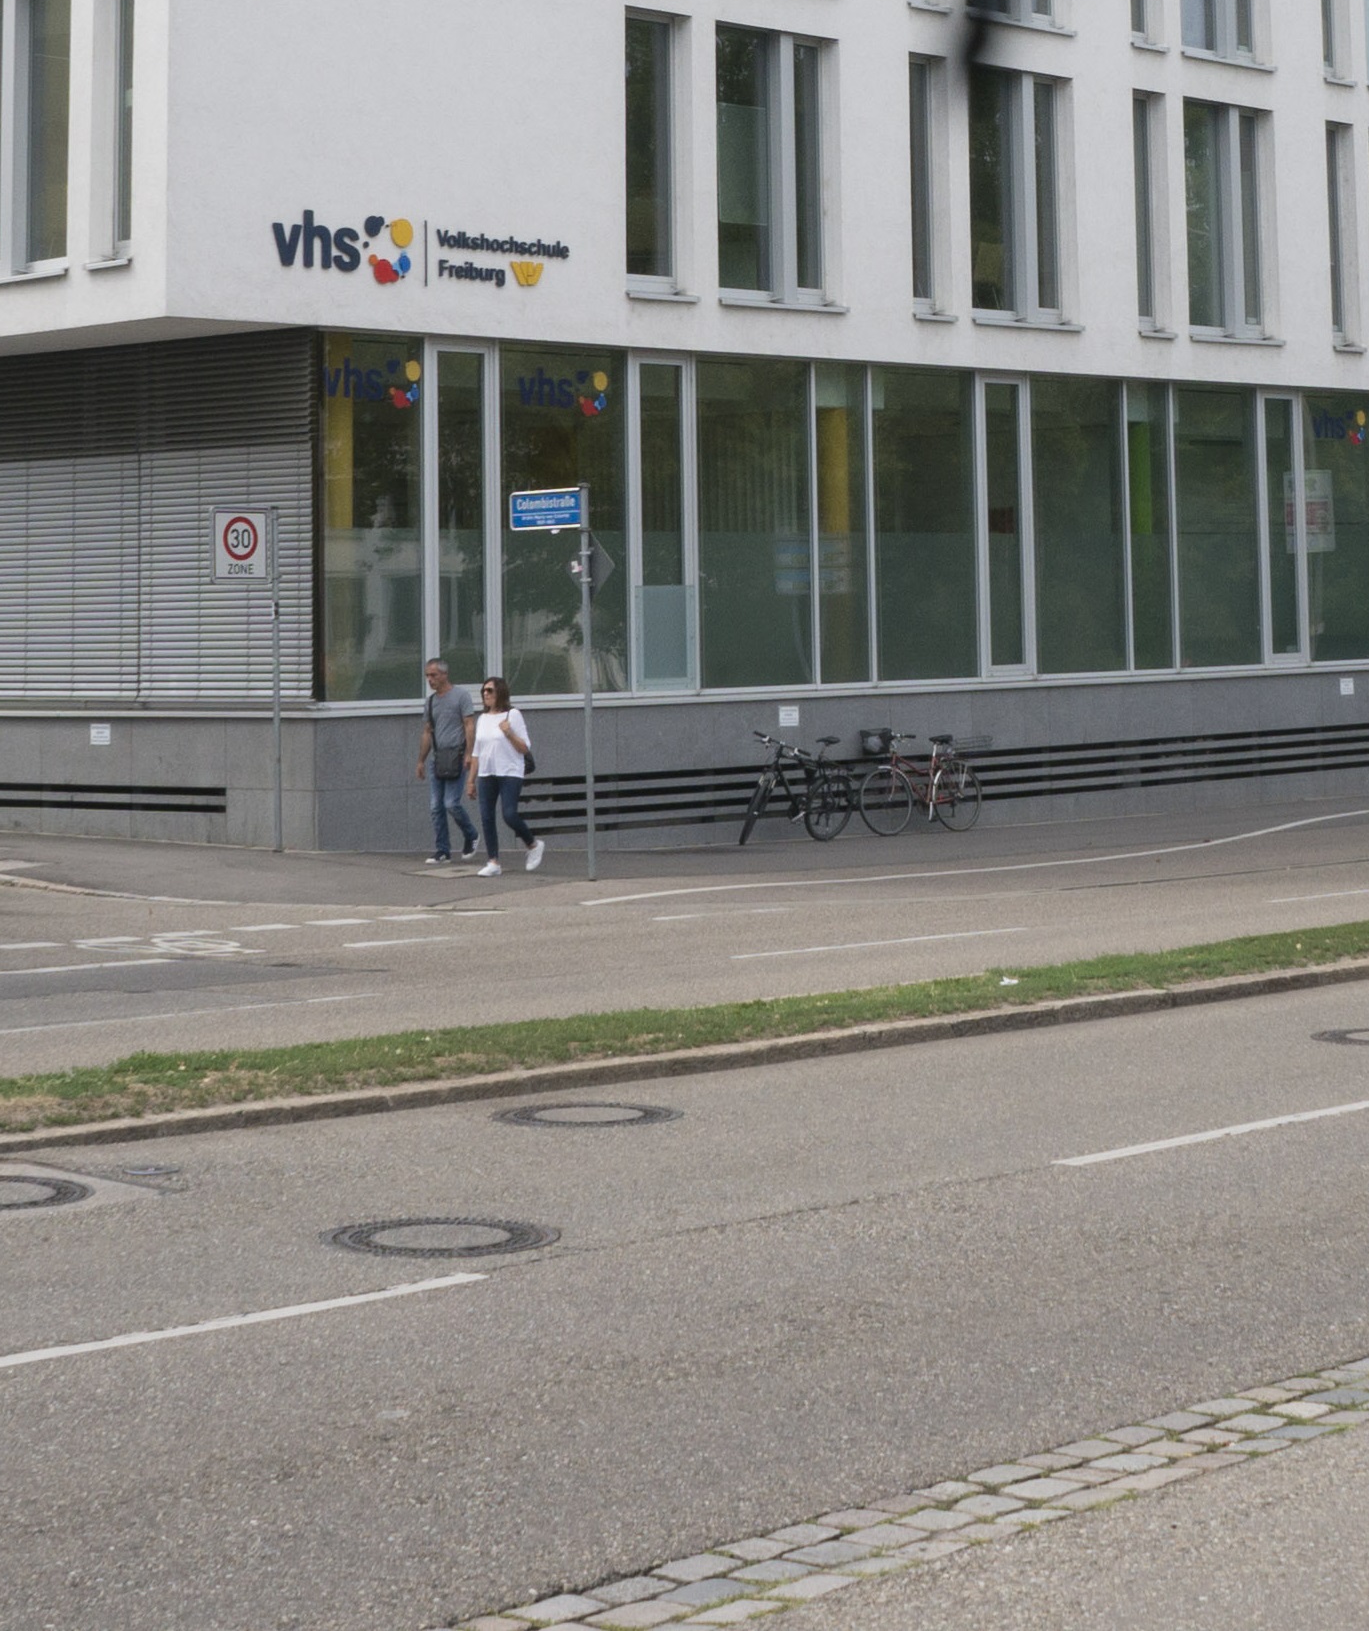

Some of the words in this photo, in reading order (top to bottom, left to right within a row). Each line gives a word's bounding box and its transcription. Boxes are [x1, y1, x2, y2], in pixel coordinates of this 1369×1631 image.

[271, 209, 361, 273] vhs
[436, 228, 570, 259] Volkshochschule
[438, 259, 506, 287] Freiburg
[324, 357, 384, 401] vhs
[518, 366, 574, 408] vhs
[516, 495, 576, 511] Colombistraße
[230, 528, 251, 549] 30
[227, 563, 254, 575] ZONE
